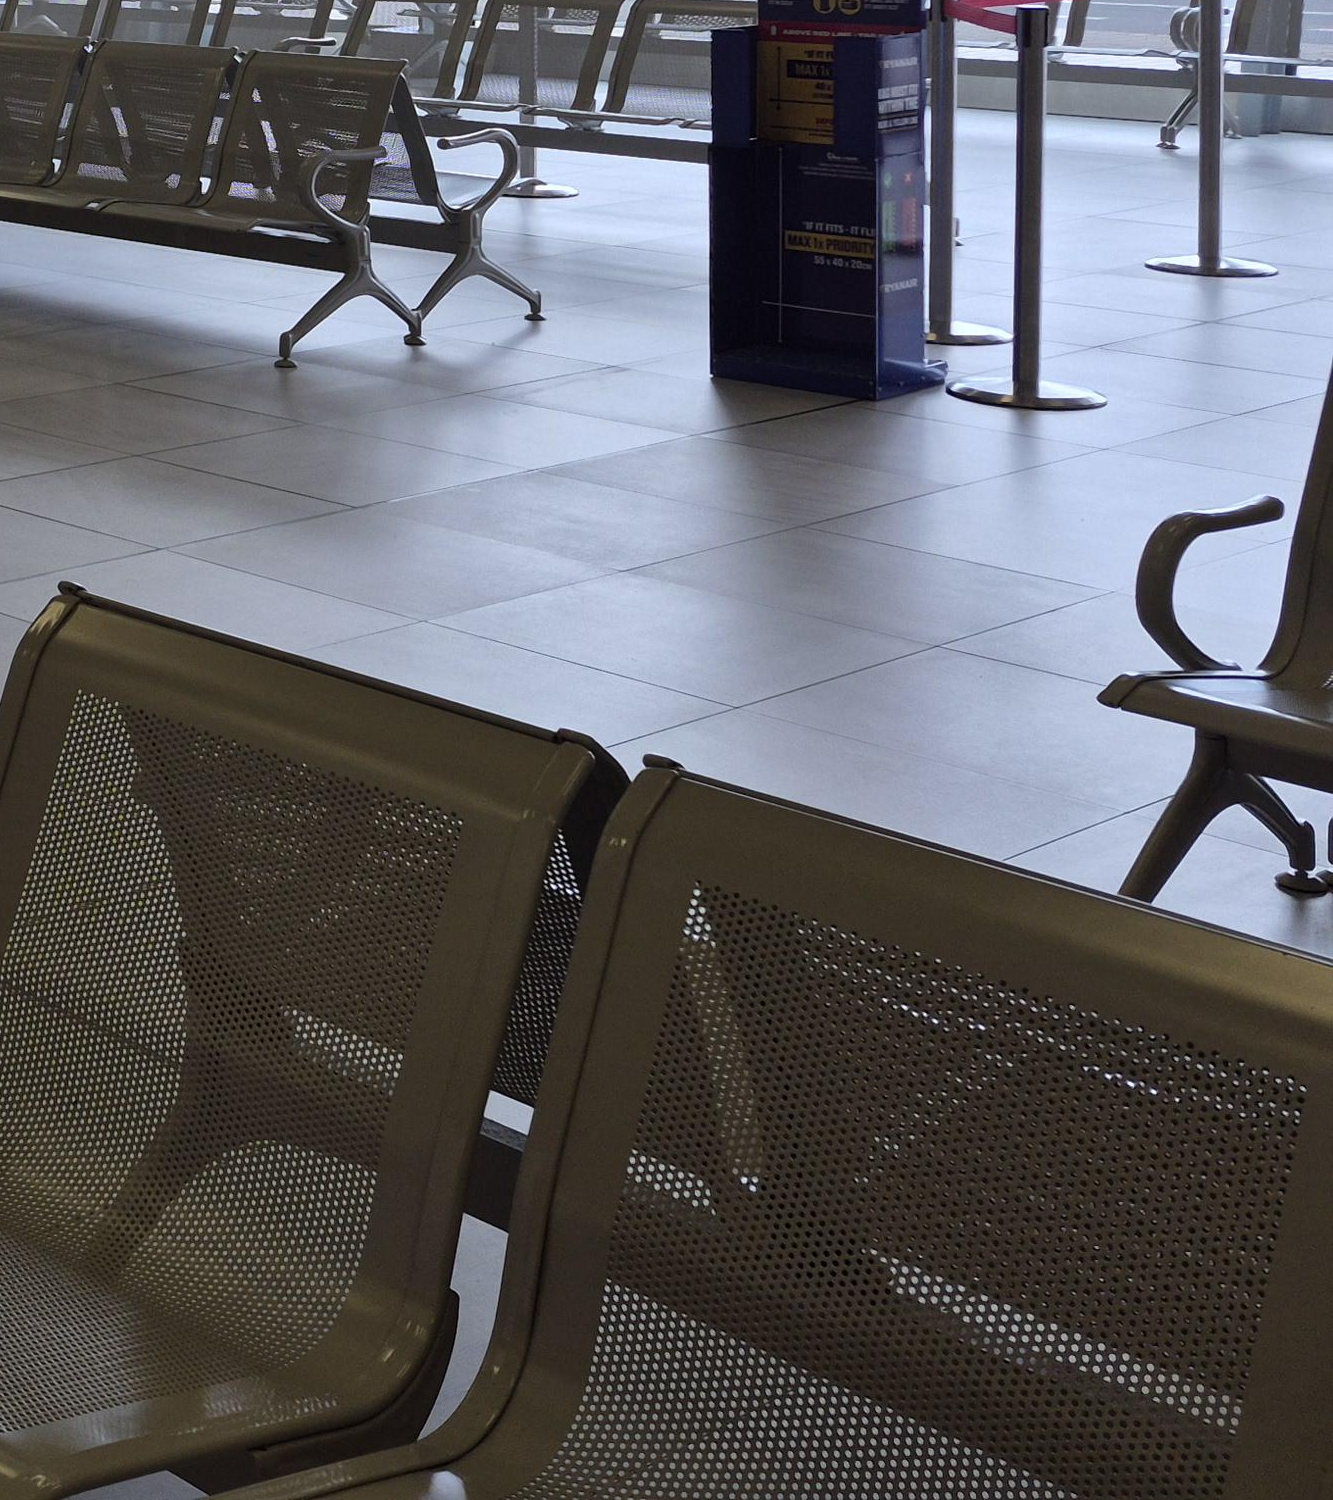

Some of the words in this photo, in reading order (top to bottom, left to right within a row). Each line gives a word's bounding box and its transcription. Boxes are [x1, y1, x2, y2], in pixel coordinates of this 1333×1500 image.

[883, 57, 918, 69] RYANAIR
[795, 63, 819, 76] MAX
[826, 223, 844, 232] FITS
[788, 234, 810, 247] MAX
[826, 239, 875, 256] PRIORITY
[813, 255, 825, 265] 55
[832, 257, 843, 267] 40
[884, 278, 918, 293] RYANAIR
